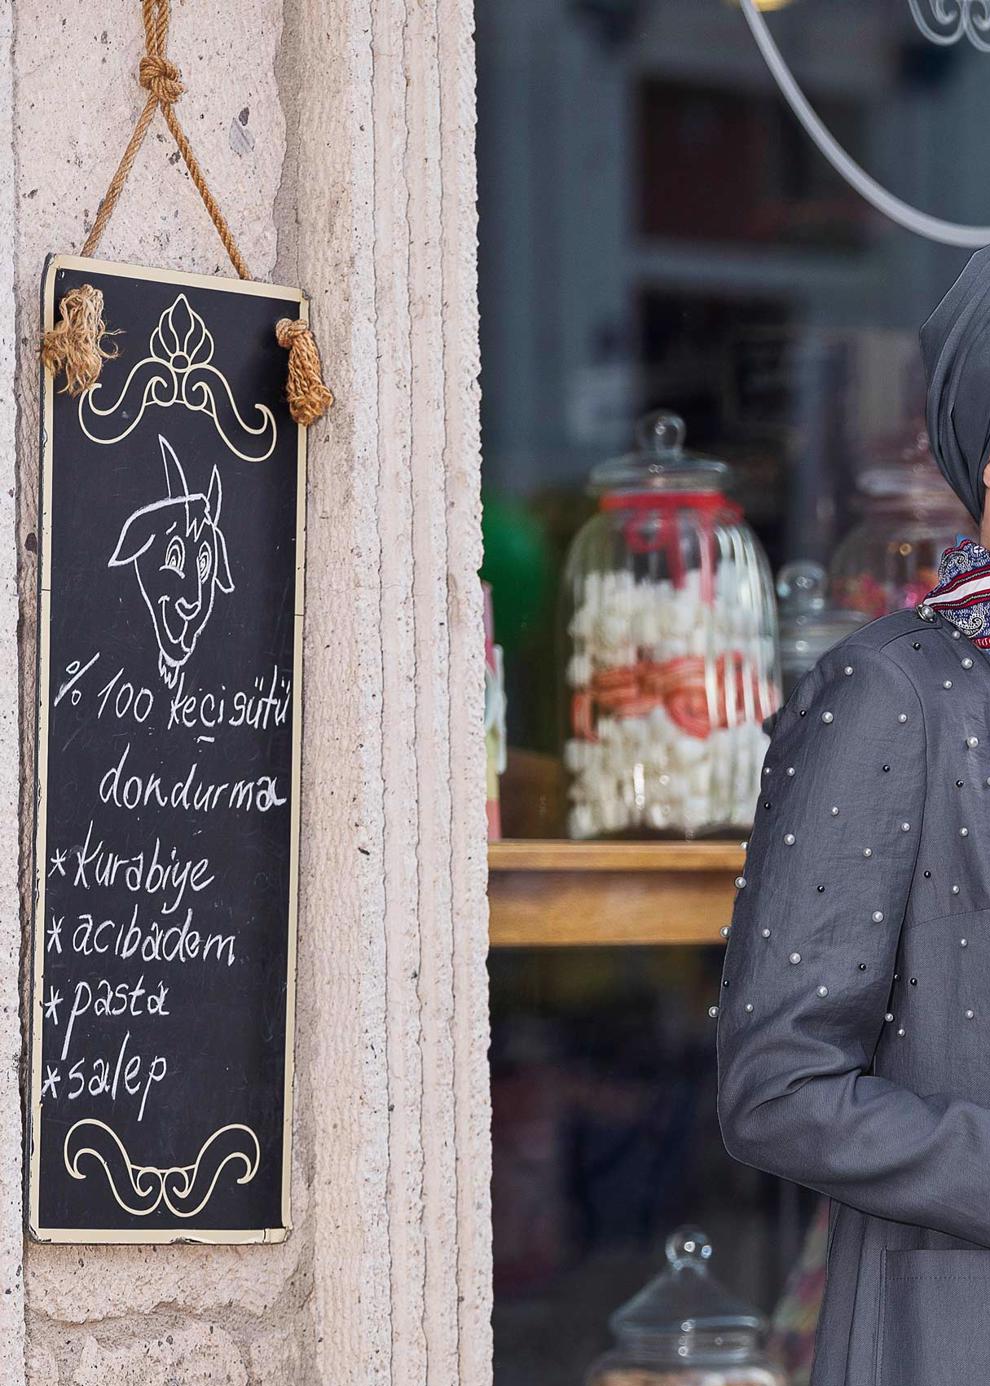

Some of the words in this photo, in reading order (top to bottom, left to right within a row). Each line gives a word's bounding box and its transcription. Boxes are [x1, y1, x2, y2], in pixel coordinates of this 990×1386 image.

[99, 743, 287, 812] dondurma
[61, 974, 170, 1060] pasta
[67, 1030, 167, 1121] salep
